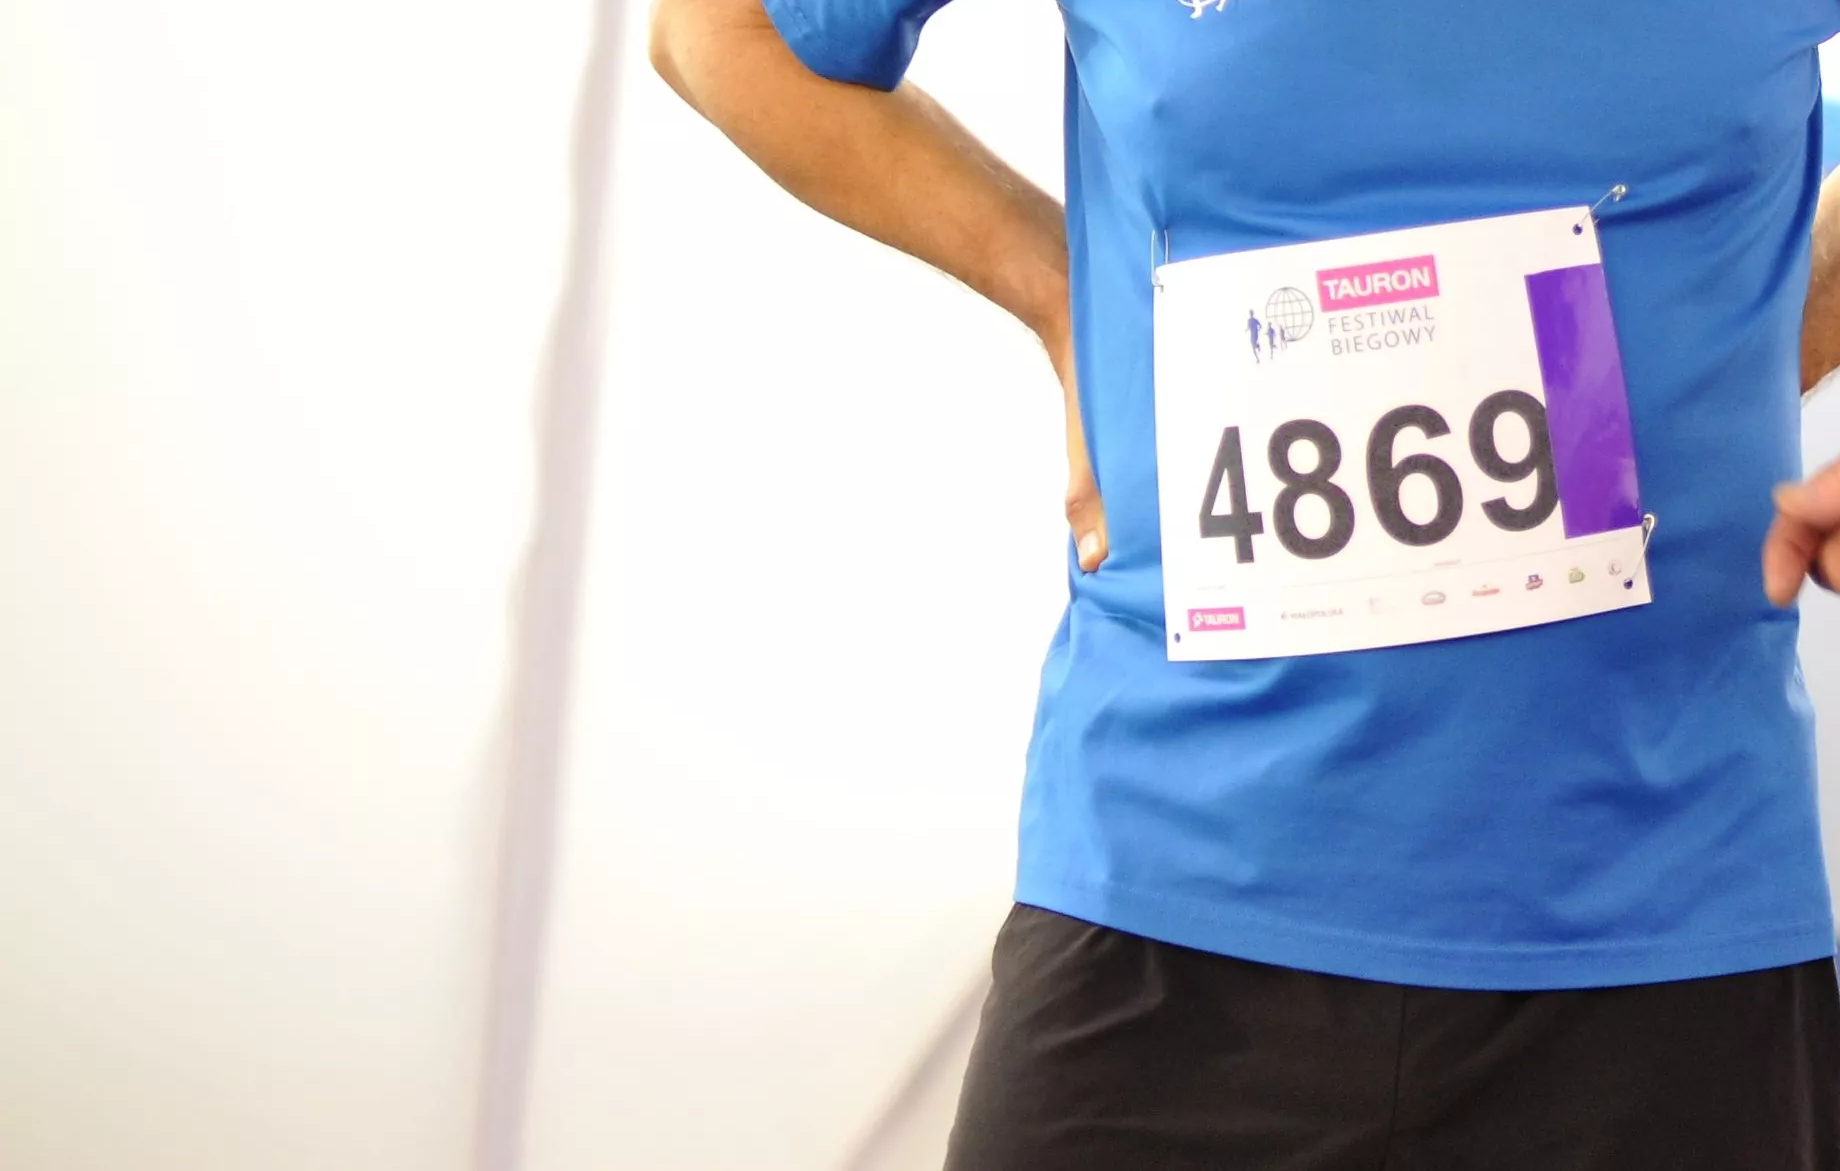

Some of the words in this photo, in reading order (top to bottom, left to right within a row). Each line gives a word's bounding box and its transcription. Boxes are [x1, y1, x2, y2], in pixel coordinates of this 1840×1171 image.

[1322, 266, 1430, 300] TAURON
[1328, 304, 1434, 334] FESTIWAL
[1331, 325, 1435, 355] BIEGOWY
[1199, 389, 1560, 564] 4869
